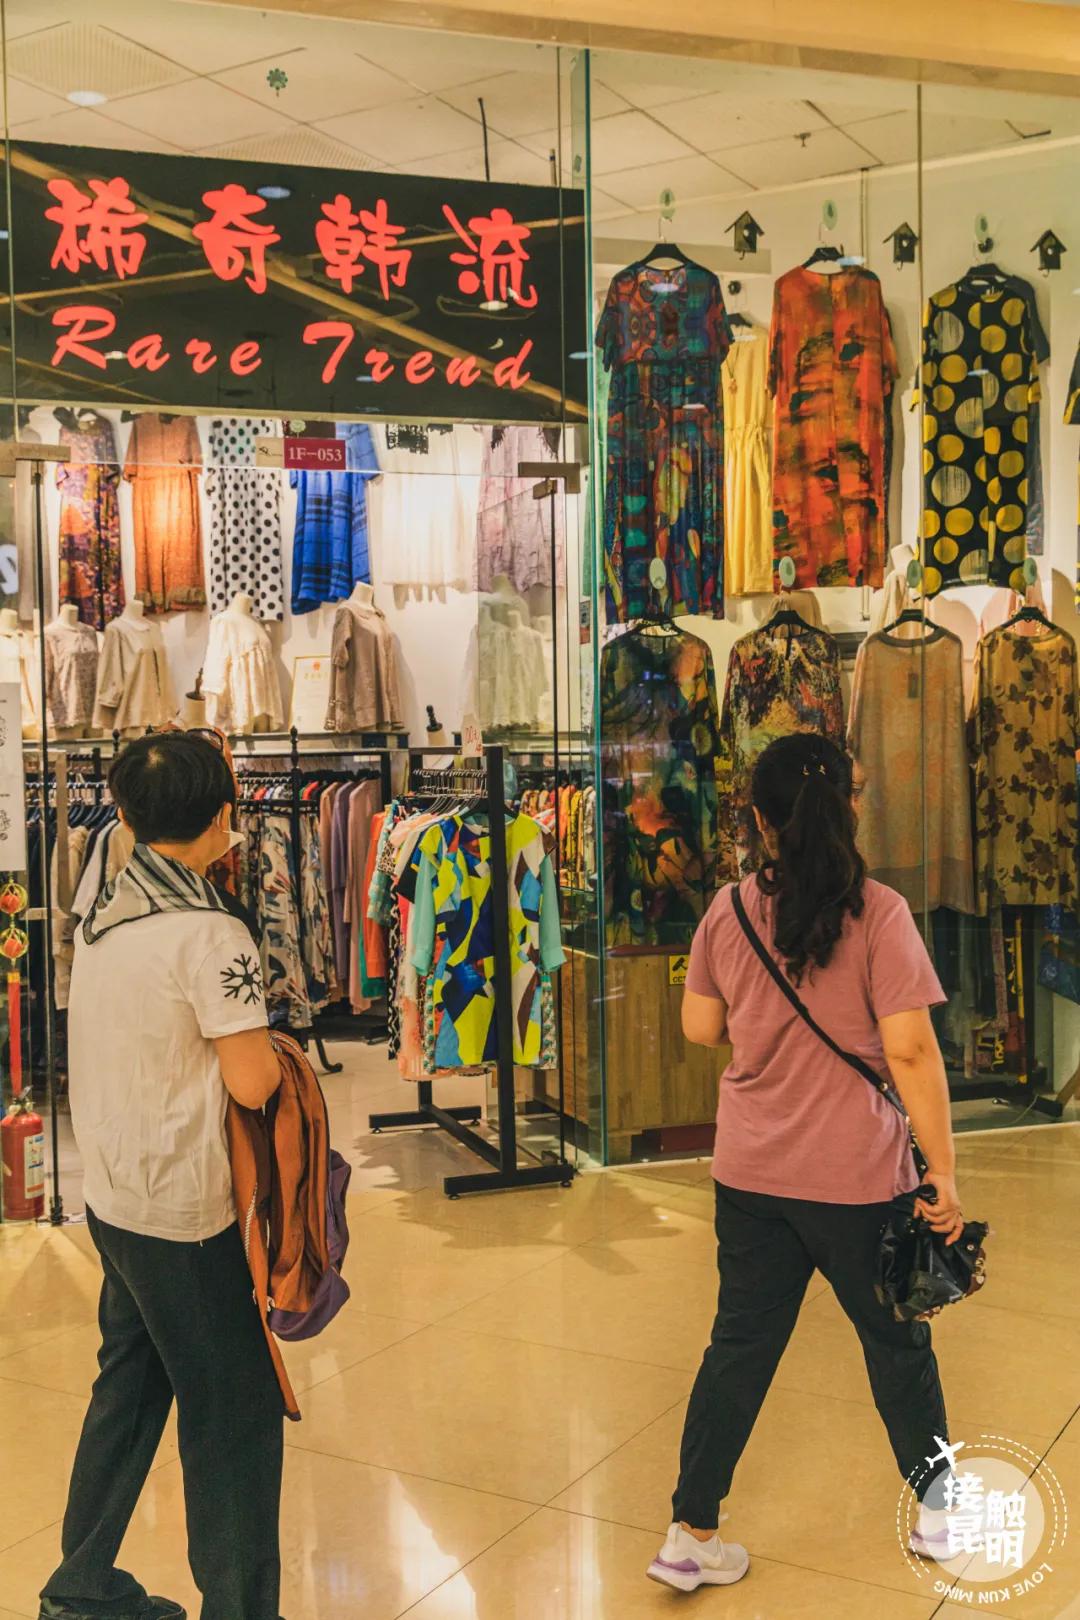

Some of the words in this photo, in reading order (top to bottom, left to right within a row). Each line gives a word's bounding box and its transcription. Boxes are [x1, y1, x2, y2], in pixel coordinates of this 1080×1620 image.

[45, 178, 537, 307] 稀奇韩流
[52, 306, 260, 375] Rare
[304, 322, 533, 388] Trend
[288, 447, 342, 462] 1F-053
